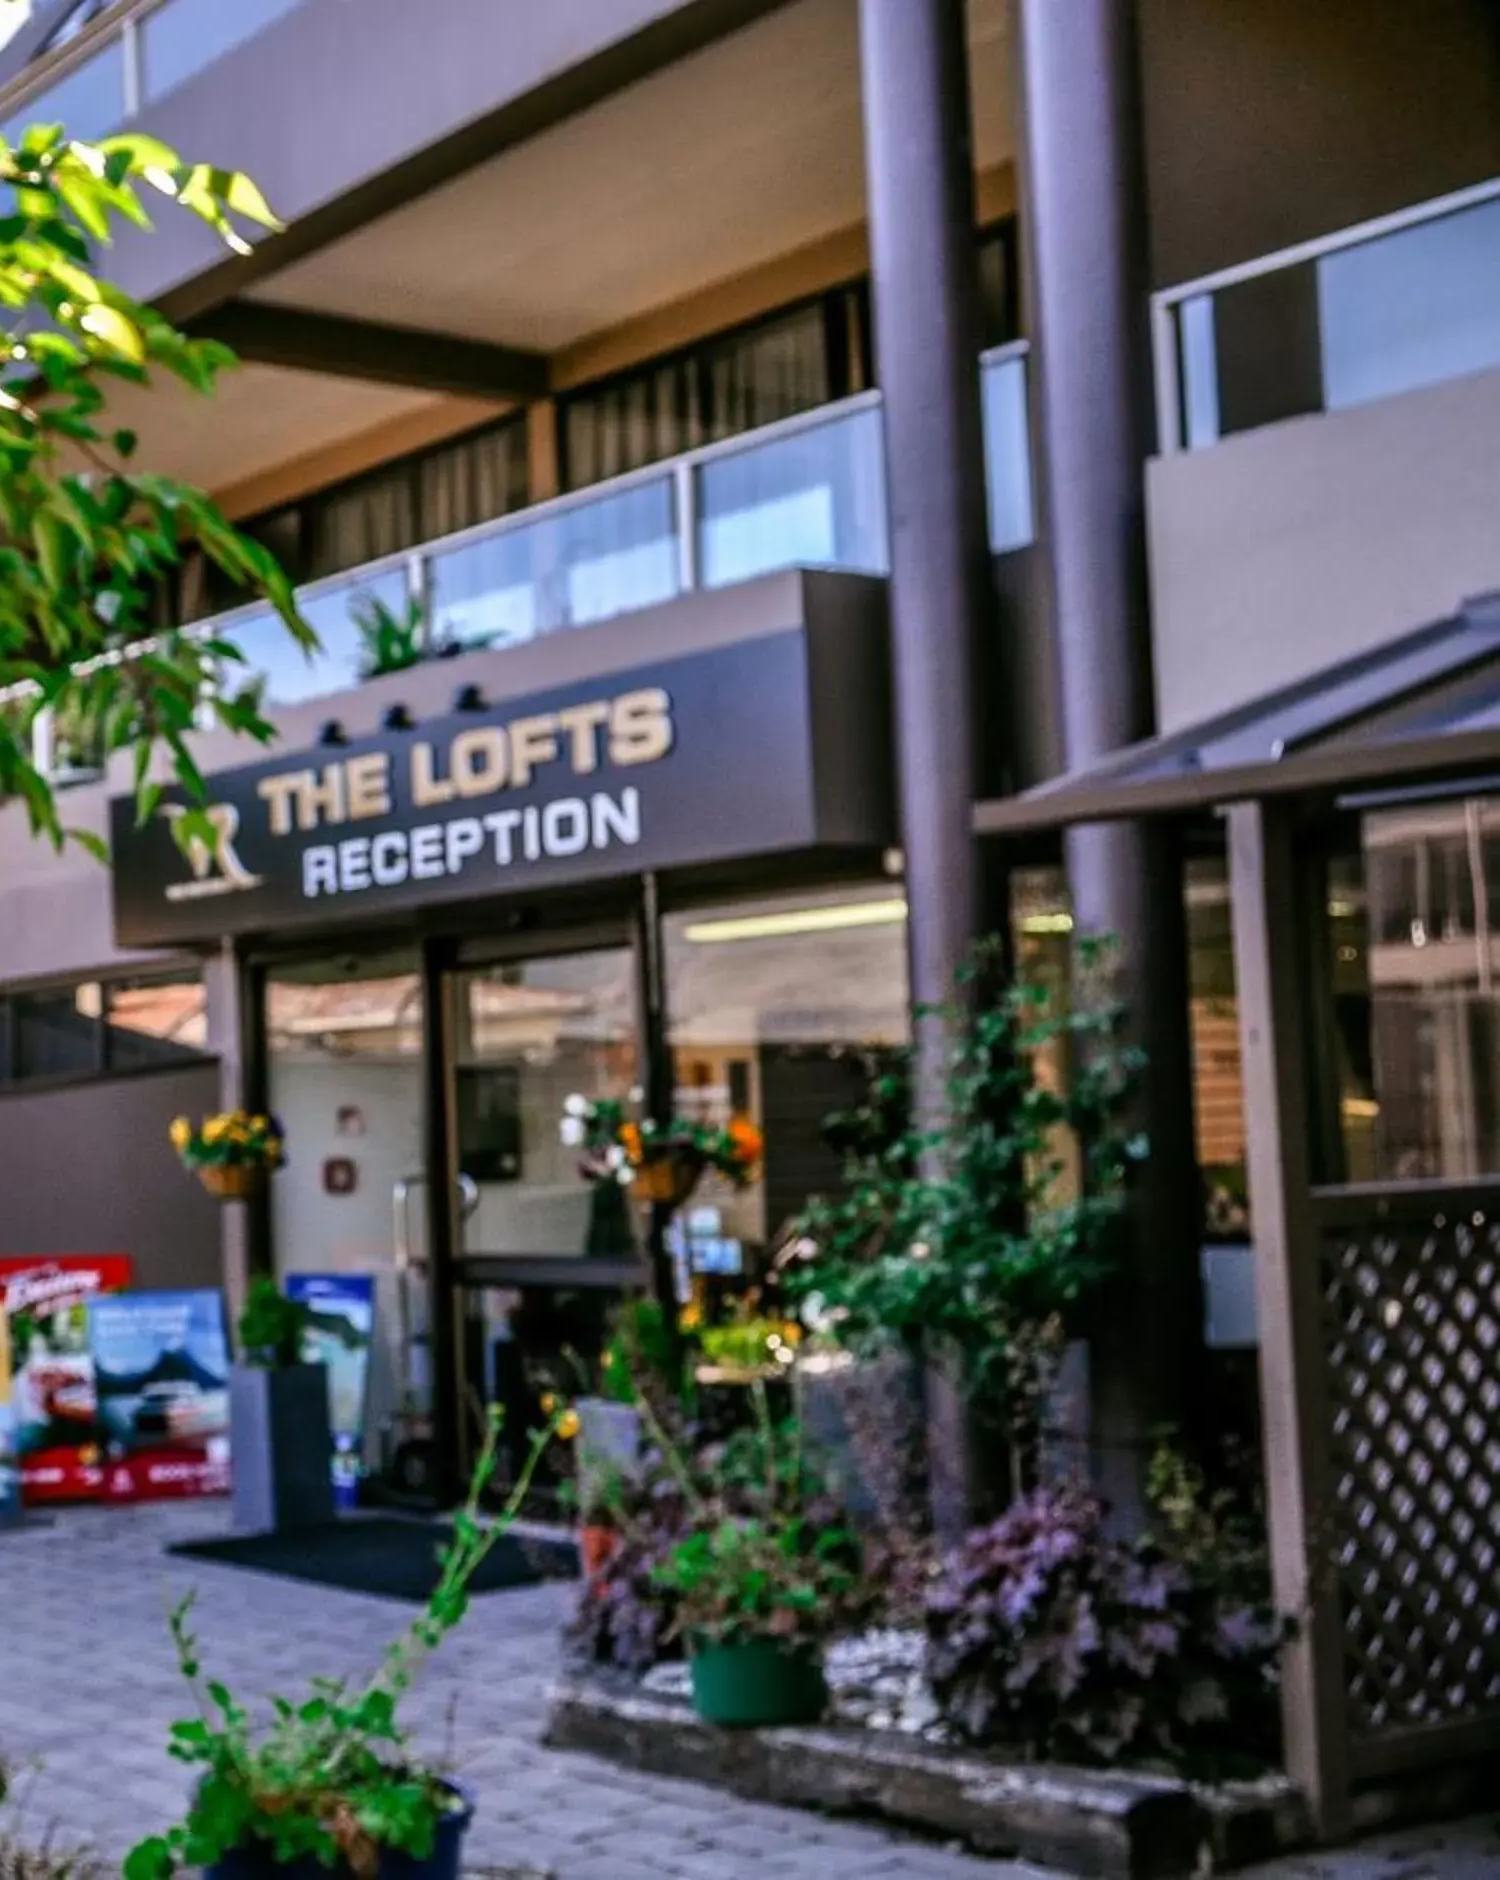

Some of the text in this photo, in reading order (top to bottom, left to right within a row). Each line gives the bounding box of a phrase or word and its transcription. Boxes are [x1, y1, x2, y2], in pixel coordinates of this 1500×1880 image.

[257, 687, 673, 836] THE LOFTS
[302, 786, 641, 898] RECEPTION
